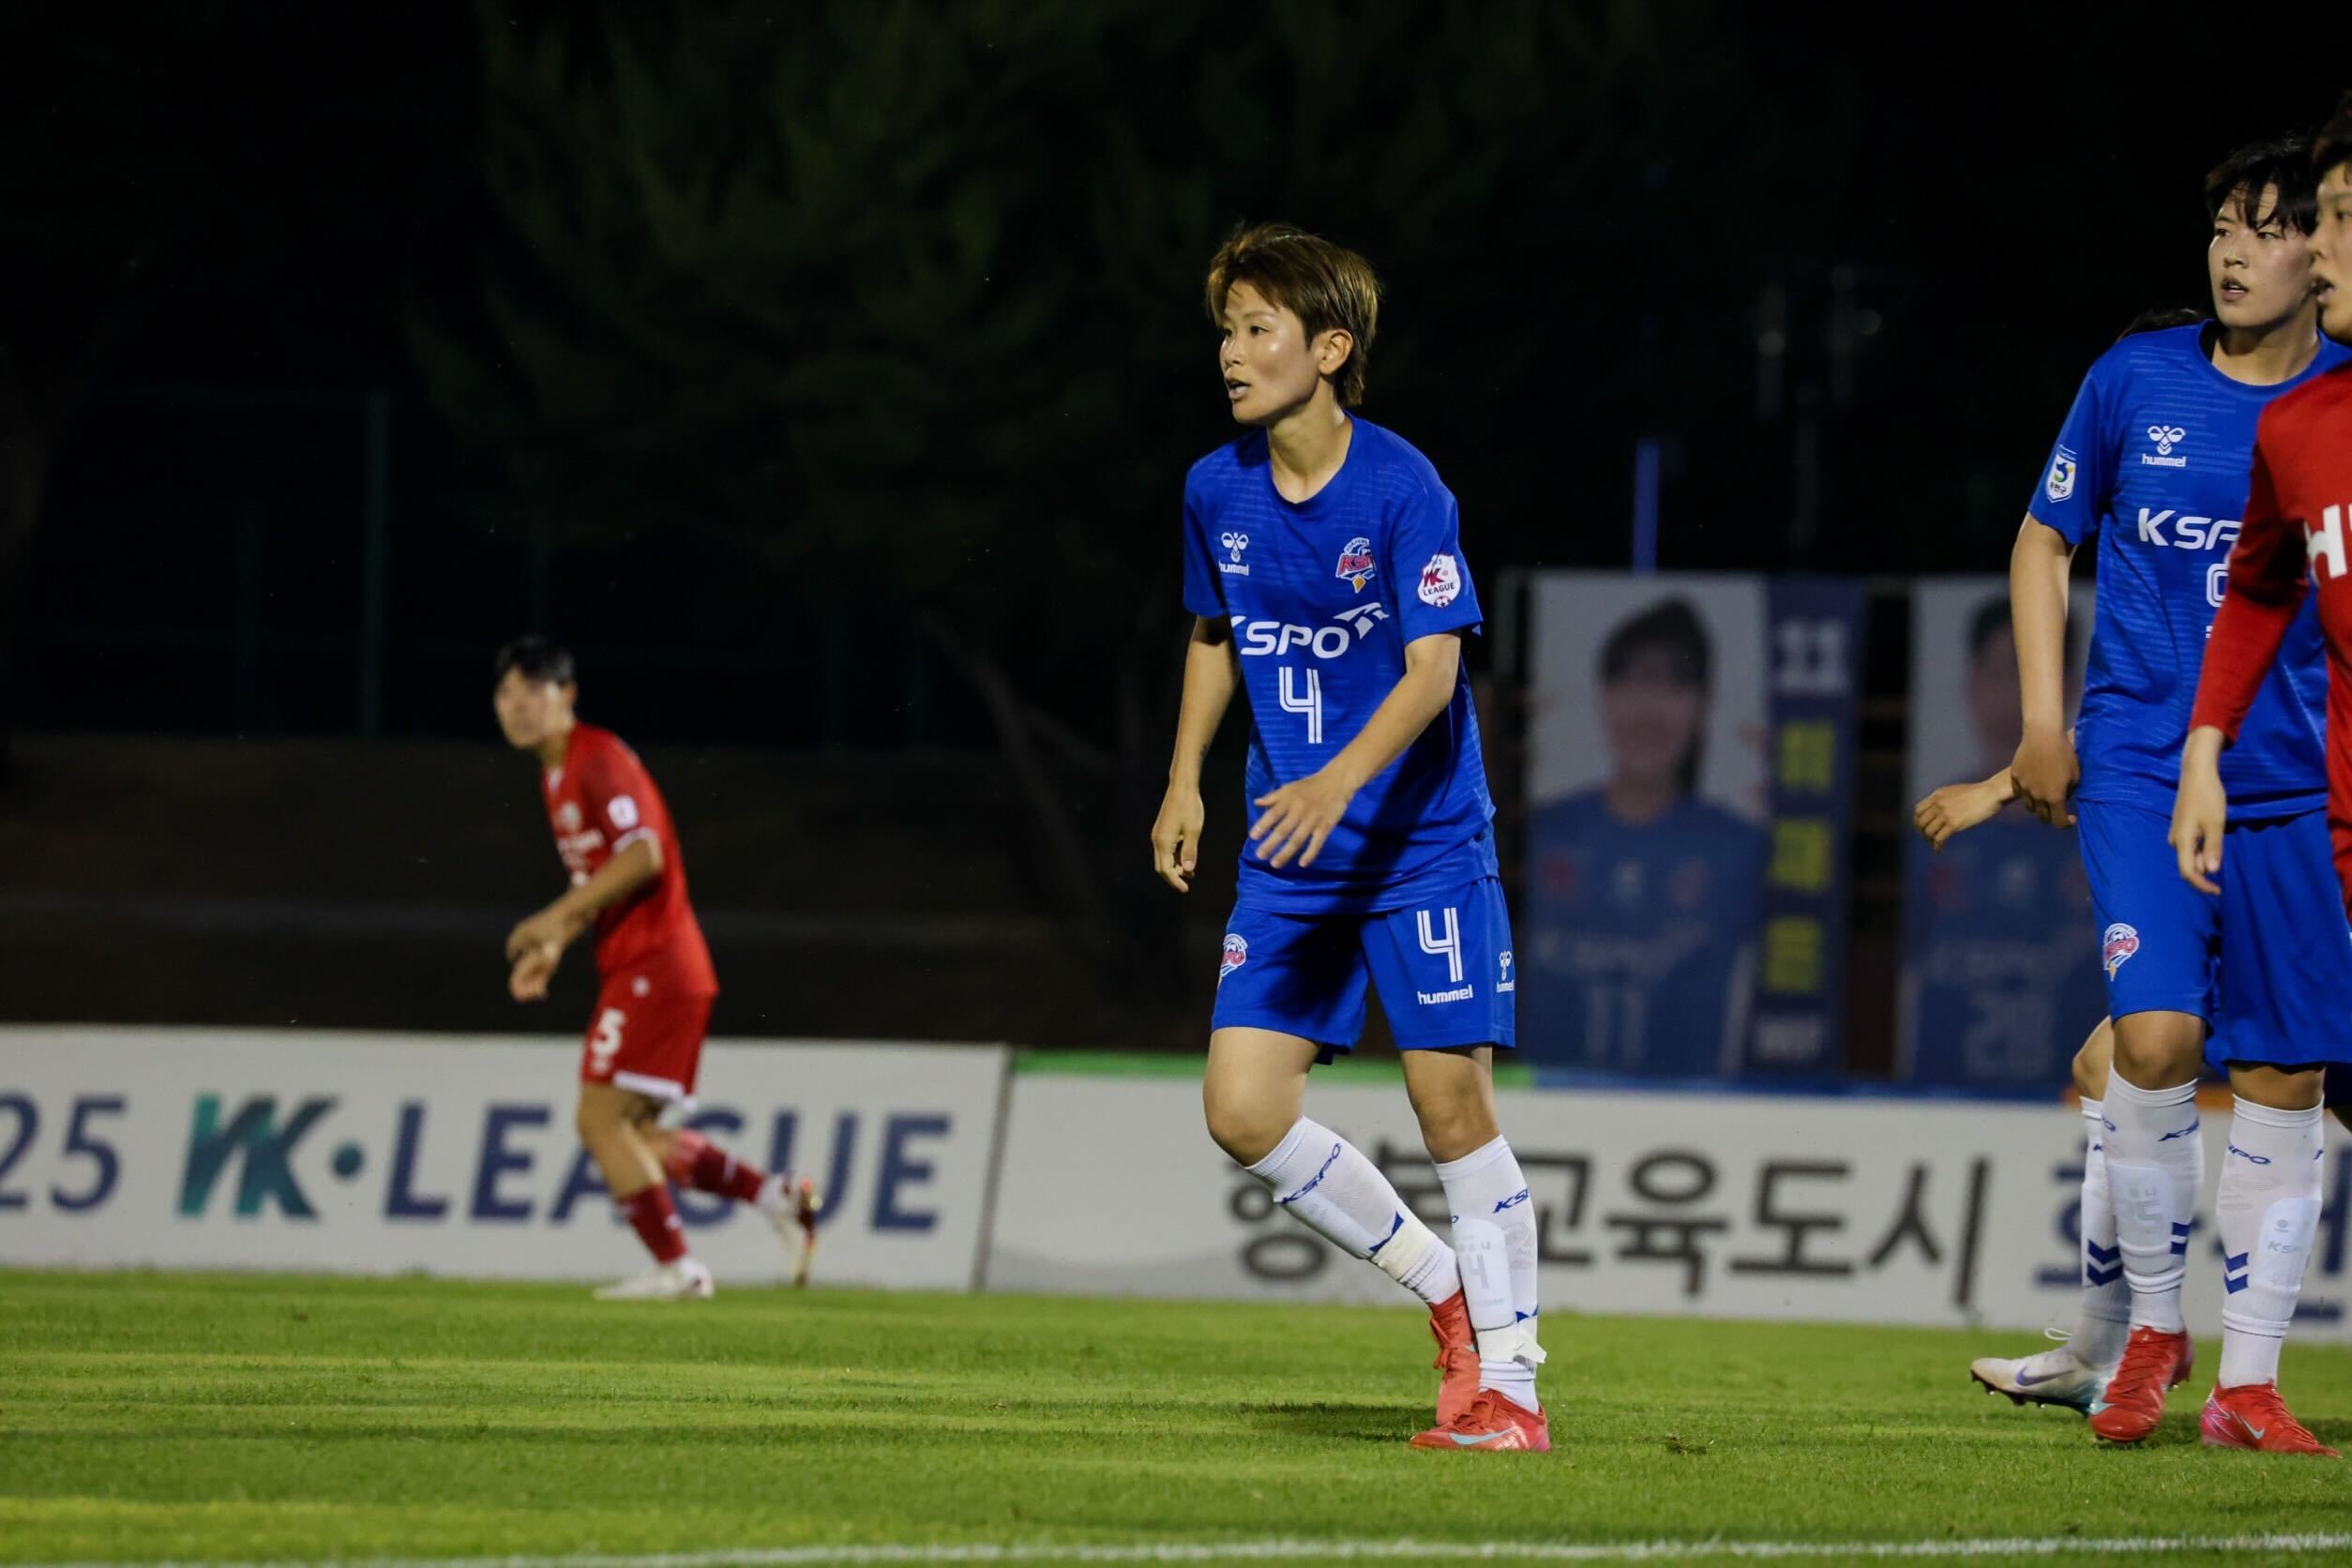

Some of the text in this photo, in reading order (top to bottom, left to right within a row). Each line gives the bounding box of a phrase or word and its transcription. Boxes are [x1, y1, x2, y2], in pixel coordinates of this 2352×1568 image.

[2142, 453, 2186, 468] hummel
[2138, 507, 2242, 550] KSP
[1423, 582, 1455, 596] LEAGUE
[1278, 667, 1322, 744] 4
[1416, 907, 1463, 983] 4
[1417, 985, 1472, 1005] hummel
[589, 1008, 626, 1057] 5
[1281, 1142, 1341, 1206] KSPO
